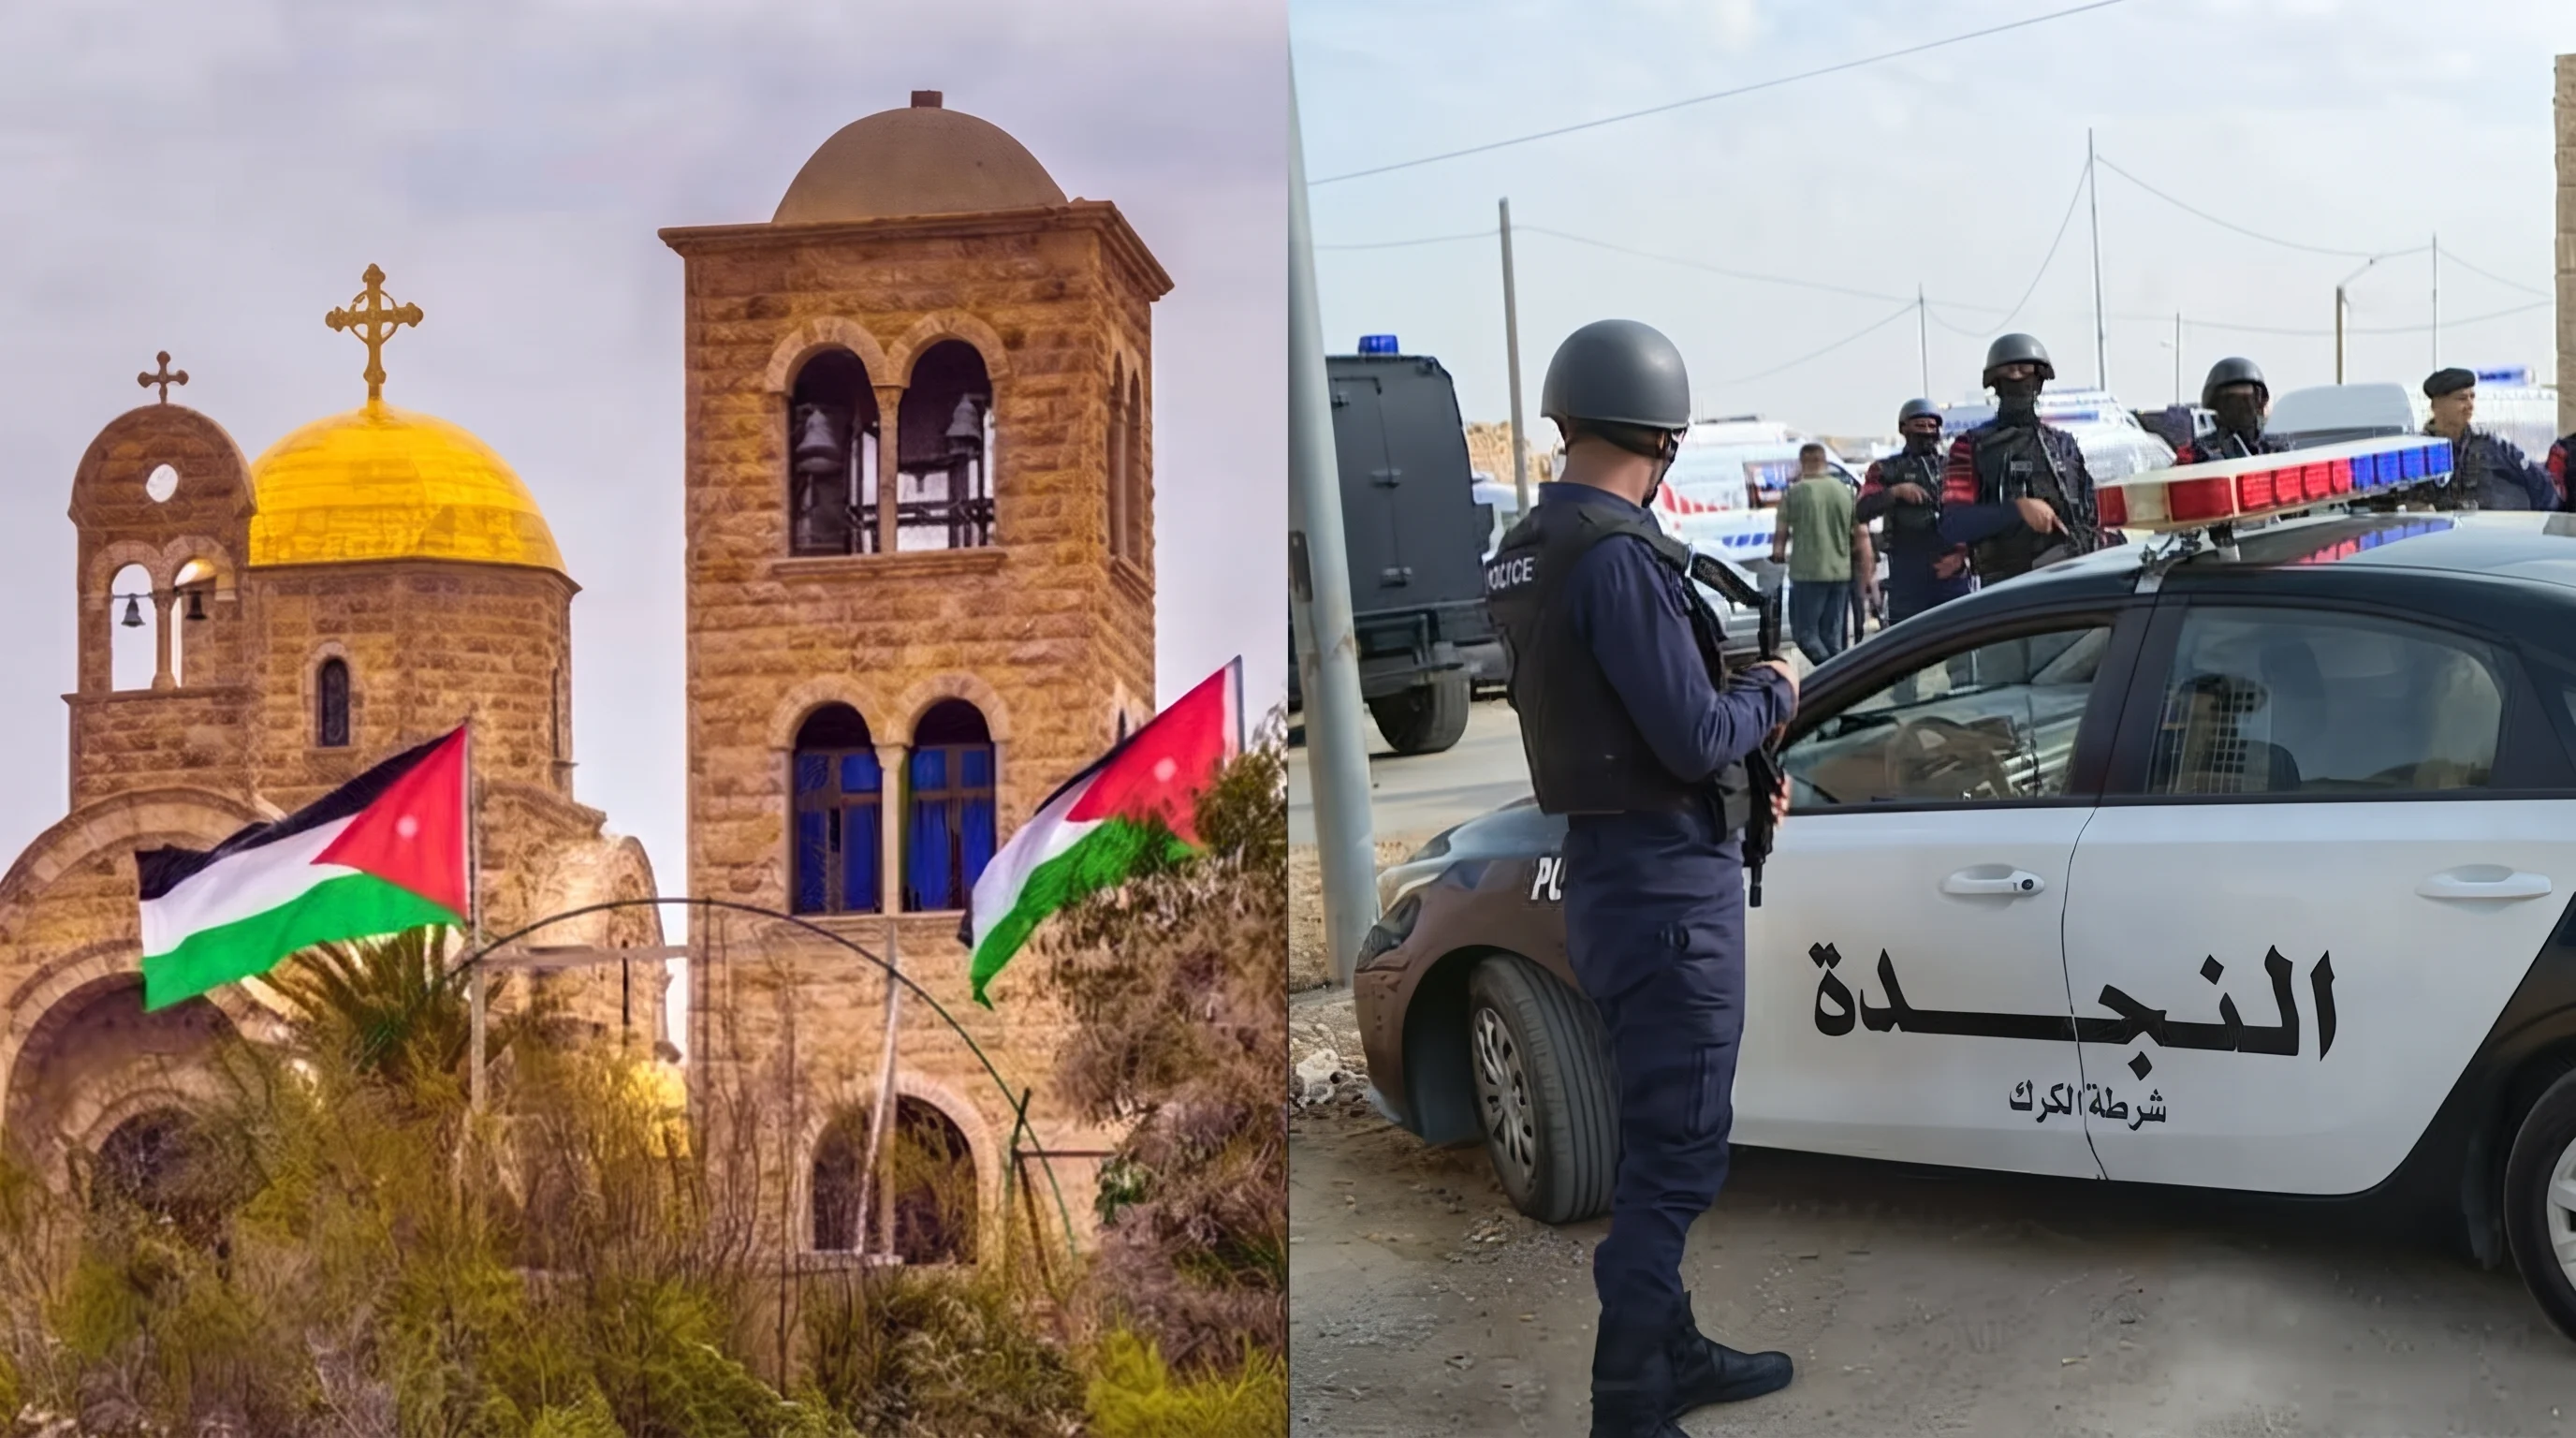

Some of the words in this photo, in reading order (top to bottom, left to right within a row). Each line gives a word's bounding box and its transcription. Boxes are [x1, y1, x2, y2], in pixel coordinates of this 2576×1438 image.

[1486, 556, 1535, 591] OLICE
[1808, 941, 2337, 1081] النجدة
[2009, 1078, 2084, 1123] الكرك
[2086, 1081, 2167, 1132] شرطة
